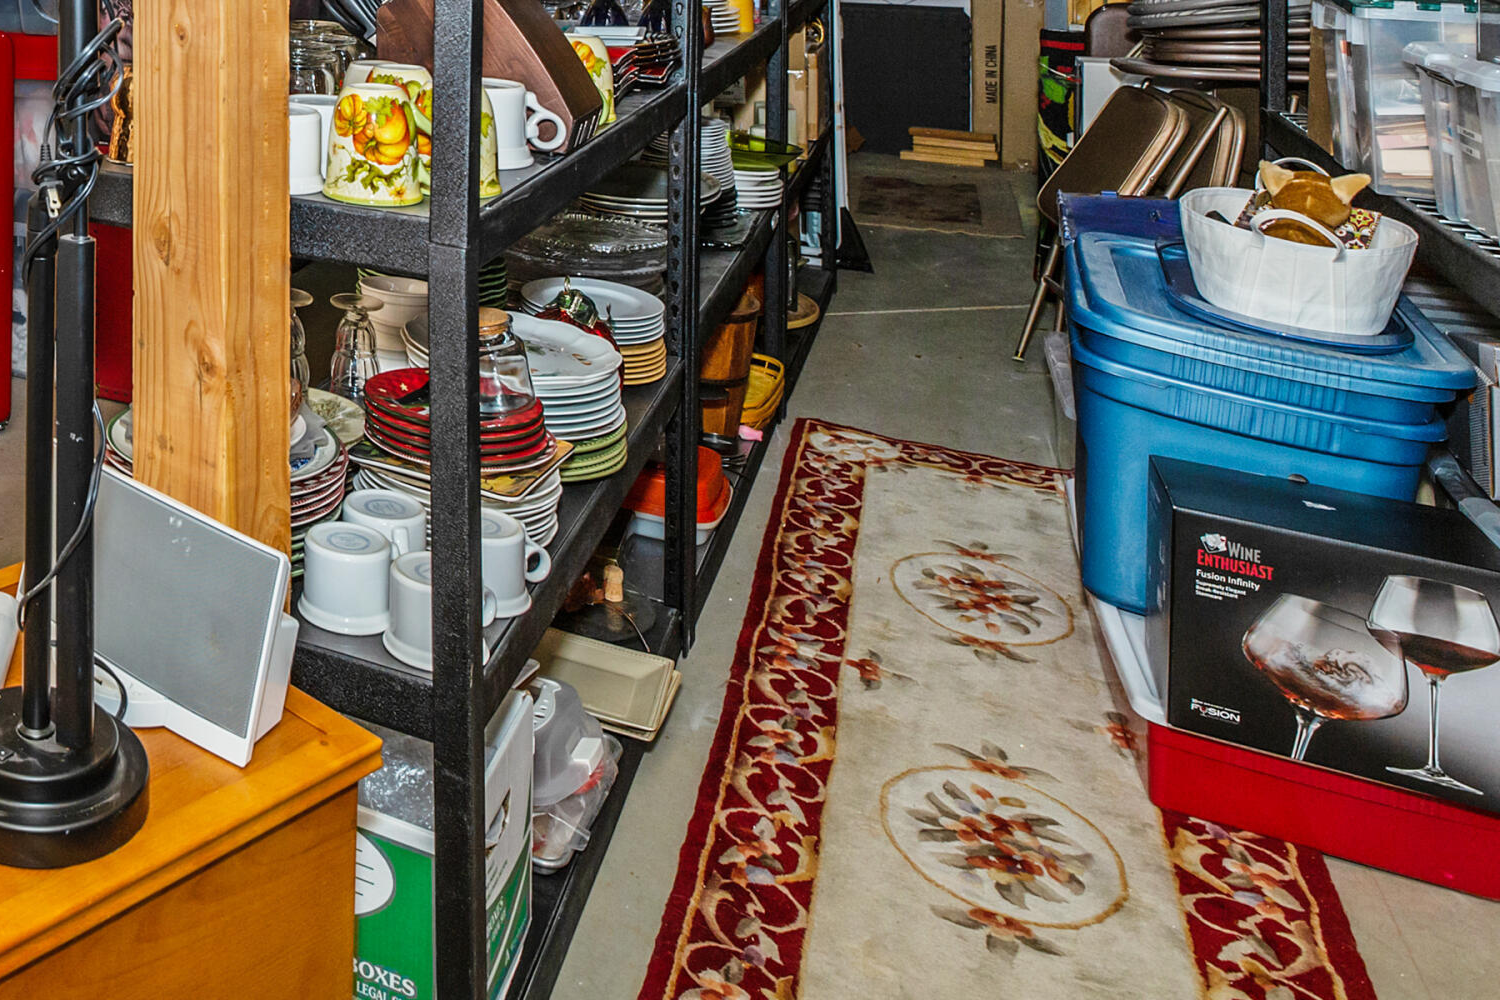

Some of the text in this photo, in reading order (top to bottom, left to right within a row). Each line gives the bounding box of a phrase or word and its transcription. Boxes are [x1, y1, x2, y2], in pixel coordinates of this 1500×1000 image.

[984, 44, 999, 105] MADE IN CHINA
[1227, 540, 1261, 564] WINE
[1196, 548, 1275, 581] ENTHUSIAST
[1195, 568, 1261, 592] Fusion Infinity
[1190, 702, 1241, 722] FUSION
